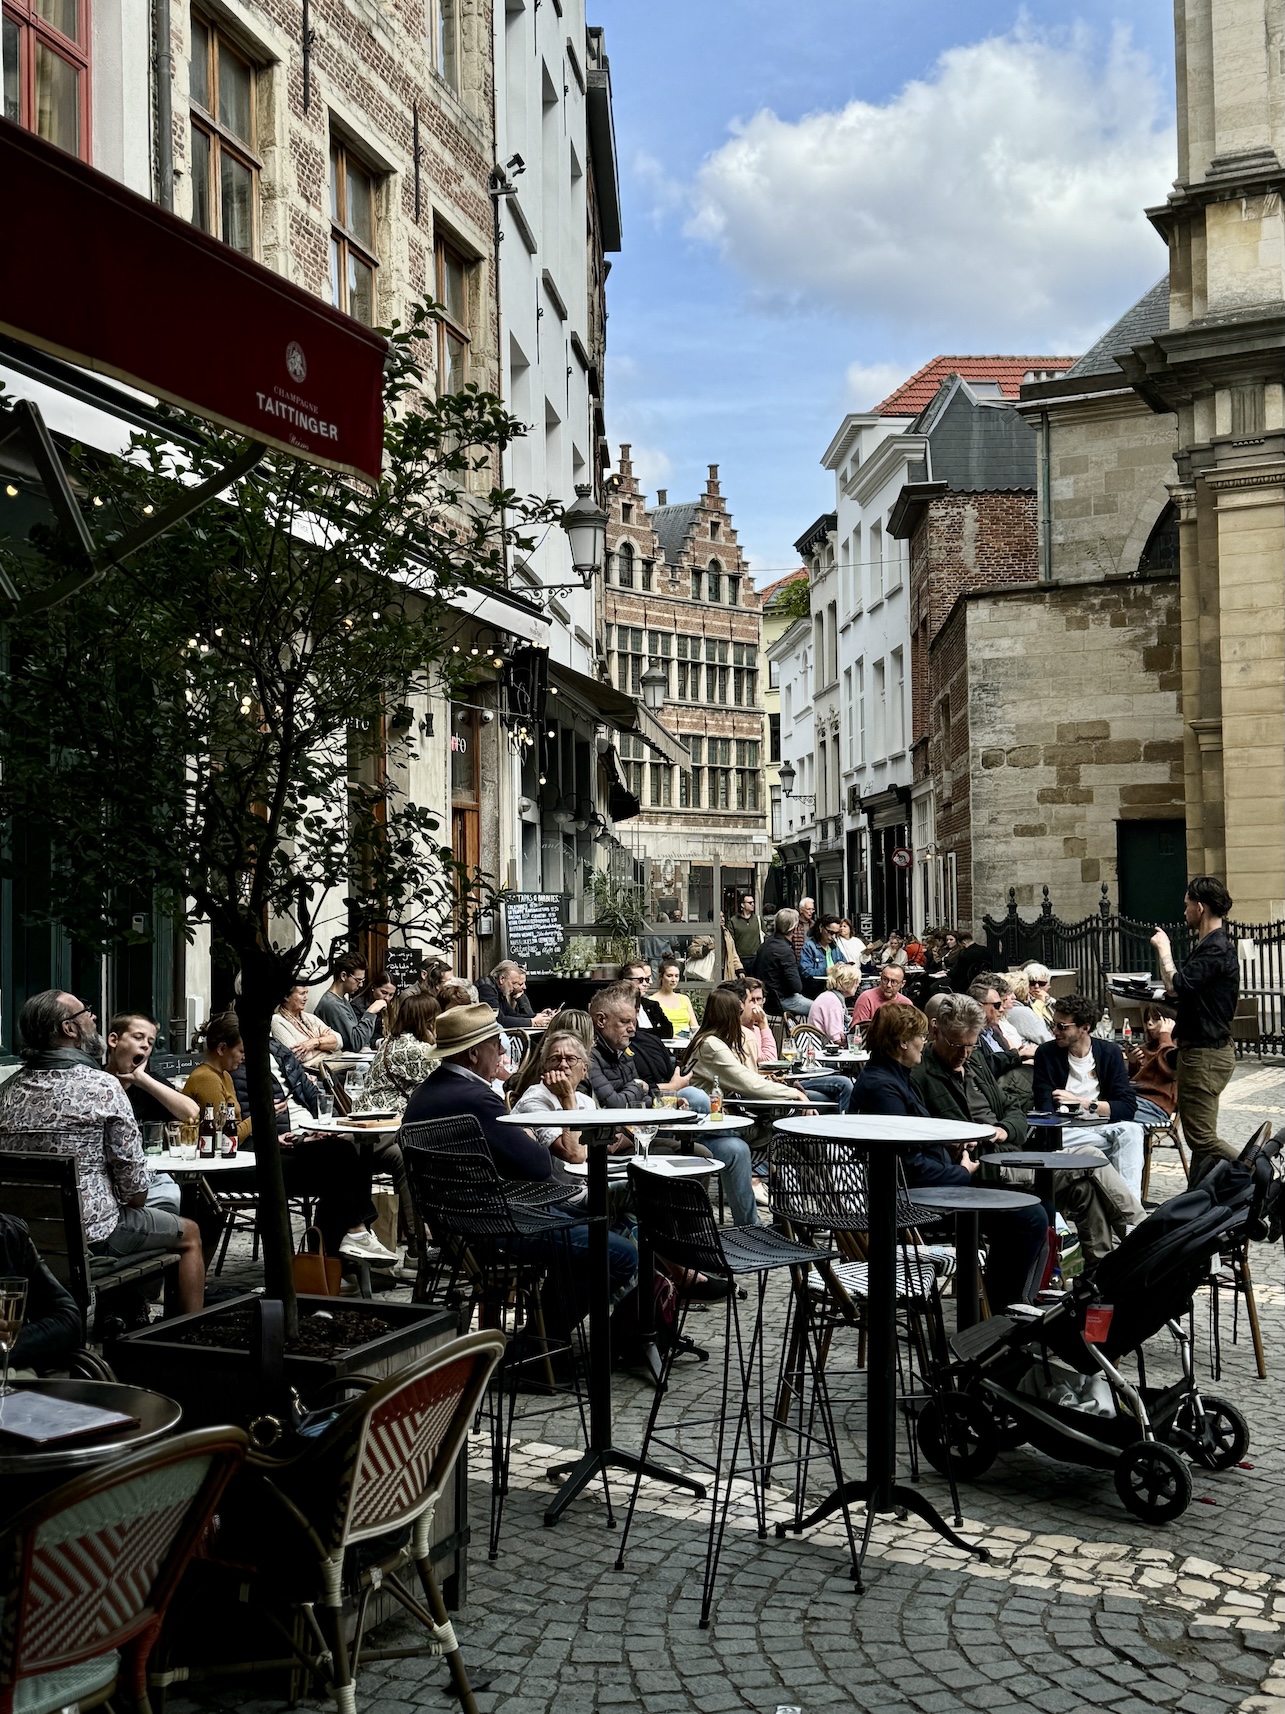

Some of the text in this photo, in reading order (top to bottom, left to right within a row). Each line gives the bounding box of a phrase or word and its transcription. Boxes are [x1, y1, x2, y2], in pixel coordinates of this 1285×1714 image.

[274, 385, 319, 414] CHAMPAGNE
[256, 391, 339, 441] TAITTINGER
[175, 1059, 193, 1074] food
